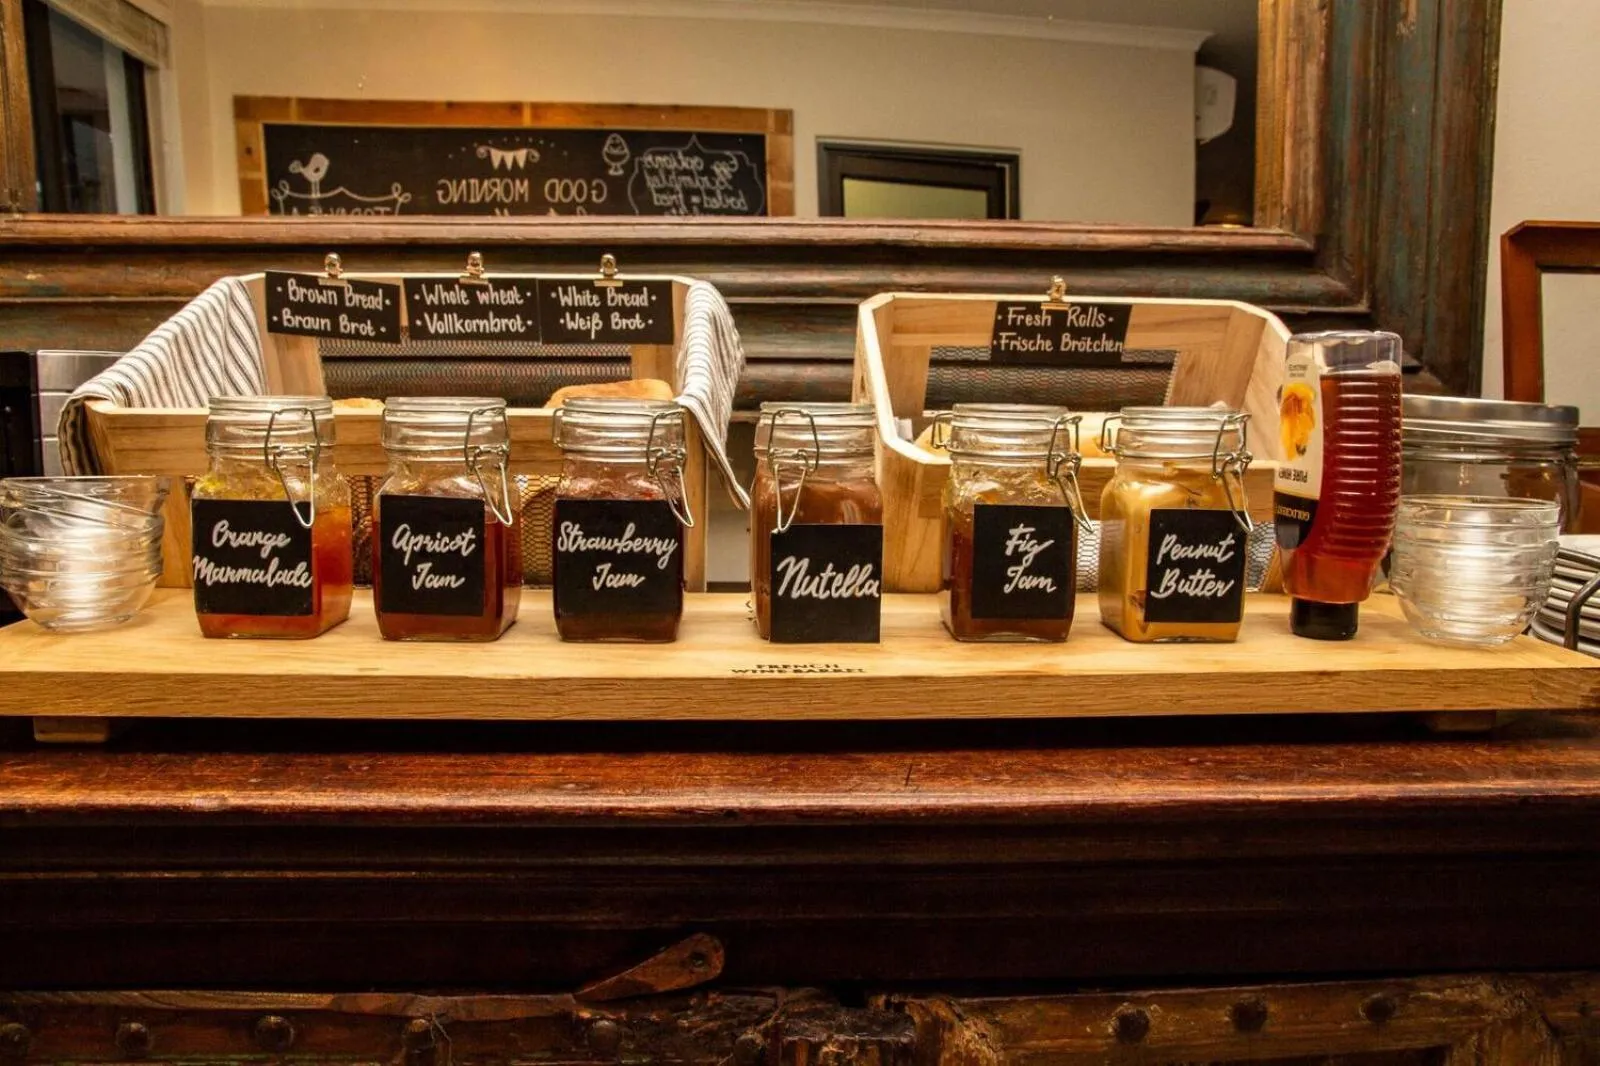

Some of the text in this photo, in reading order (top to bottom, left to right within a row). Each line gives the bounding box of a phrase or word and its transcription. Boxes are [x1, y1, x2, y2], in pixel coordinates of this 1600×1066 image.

[288, 278, 383, 310] Brown Bread
[421, 283, 524, 306] Whole wheat
[556, 285, 649, 307] White Bread
[282, 307, 376, 336] Braun Brot
[425, 310, 526, 334] Vollkornbrot
[565, 311, 645, 339] Weiß Brot
[1007, 306, 1106, 327] Fresh Rolls
[999, 332, 1124, 352] Frische Brötchen
[212, 519, 291, 559] Orange
[391, 523, 477, 565] Apricot
[557, 521, 678, 569] Strawberry
[1005, 523, 1055, 568] Fig
[1157, 532, 1236, 564] Peanut
[192, 555, 314, 588] Marmalade
[411, 562, 466, 590] Jam
[592, 562, 647, 591] Jam
[776, 555, 881, 600] Nutella
[1003, 565, 1057, 594] Jam
[1150, 568, 1235, 598] Butter
